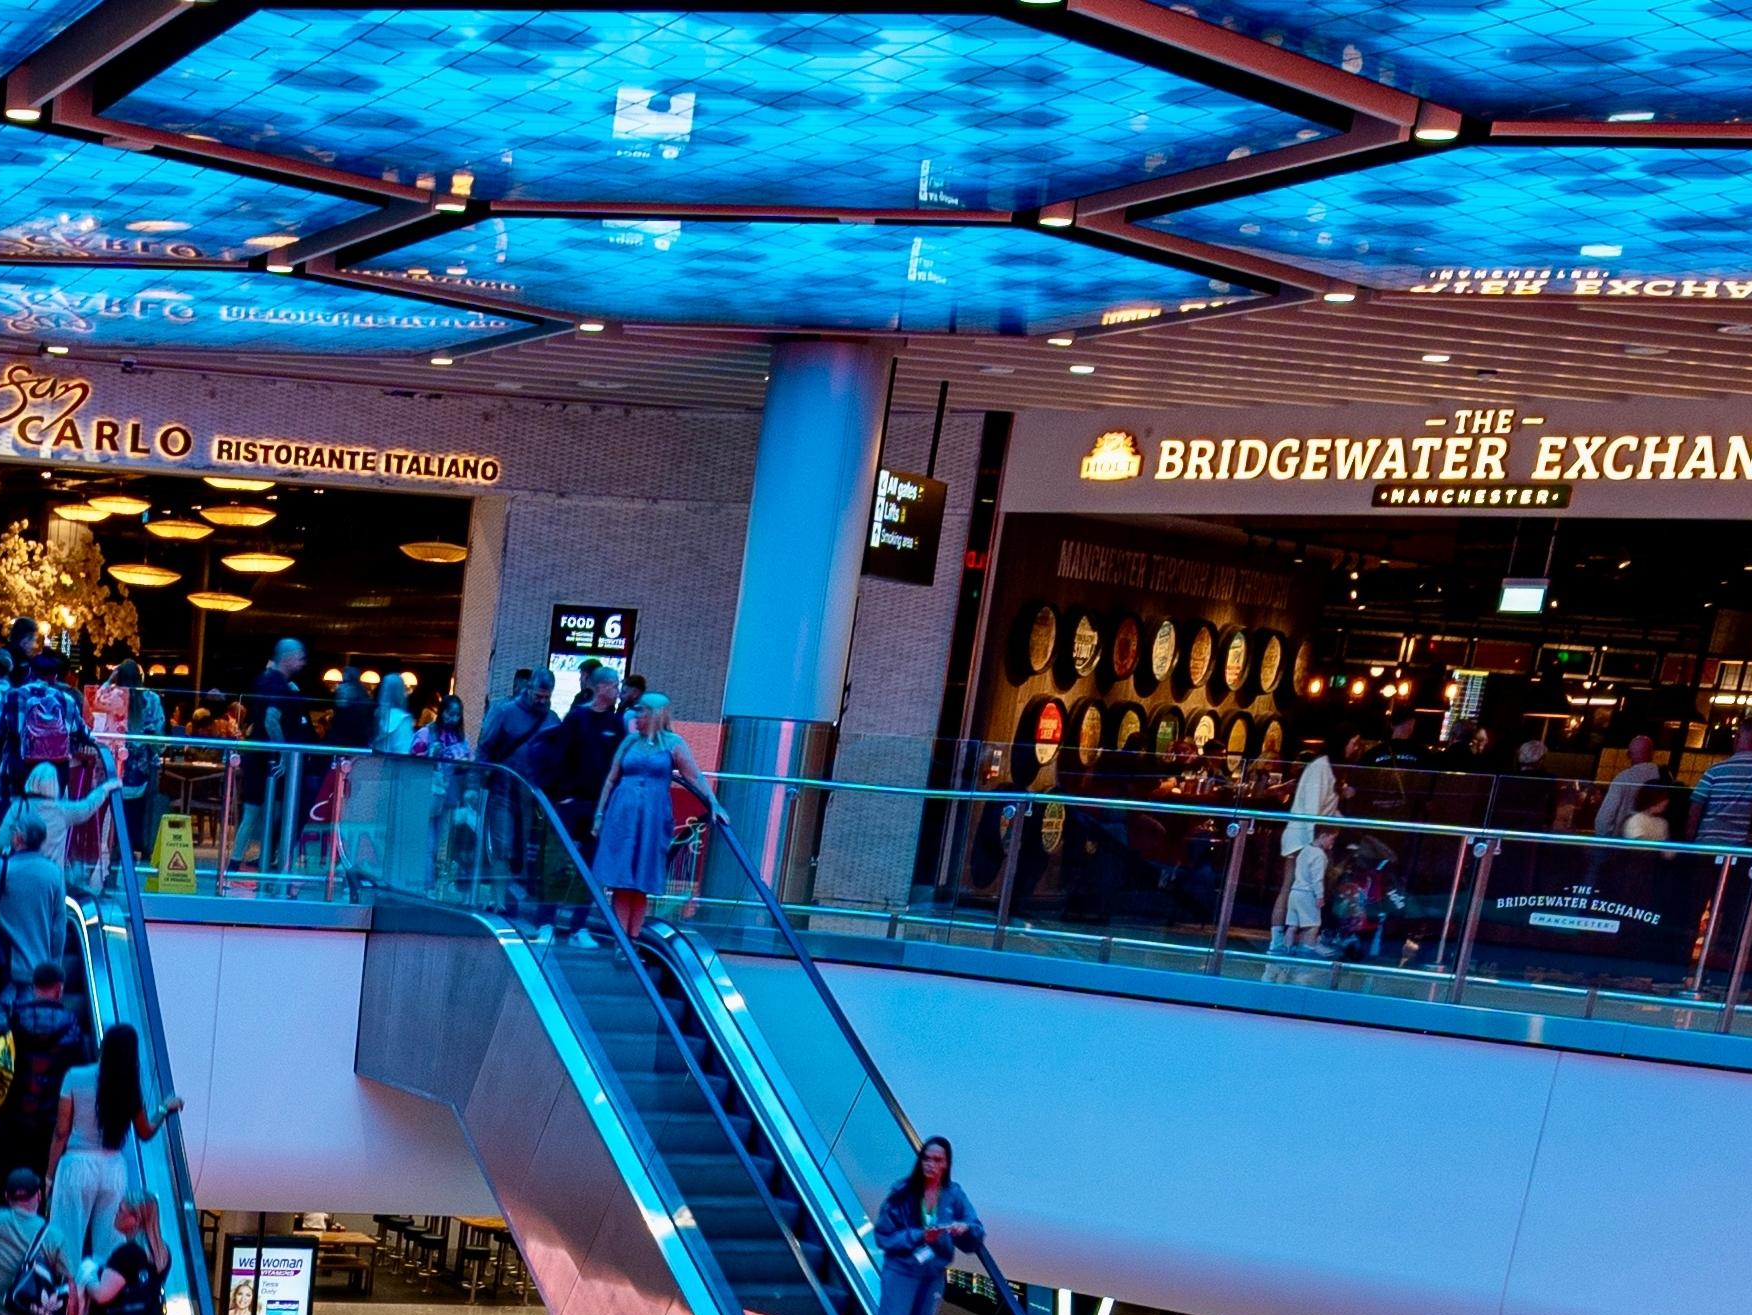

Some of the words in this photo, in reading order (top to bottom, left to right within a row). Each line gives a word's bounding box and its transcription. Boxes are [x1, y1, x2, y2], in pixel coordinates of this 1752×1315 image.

[1454, 409, 1516, 436] THE
[17, 414, 194, 458] CARLO
[216, 436, 378, 476] RISTORANTE
[383, 450, 500, 483] ITALIANO
[1083, 456, 1141, 479] HOLT
[1154, 437, 1510, 481] BRIDGEWATER
[1392, 489, 1551, 506] MANCHESTER
[560, 616, 595, 629] FOOD
[604, 614, 622, 638] 6
[1571, 885, 1593, 895] THE
[1496, 895, 1589, 911] BRIDGEWATER
[1590, 899, 1661, 925] EXCHANGE
[239, 1257, 303, 1269] wewoman
